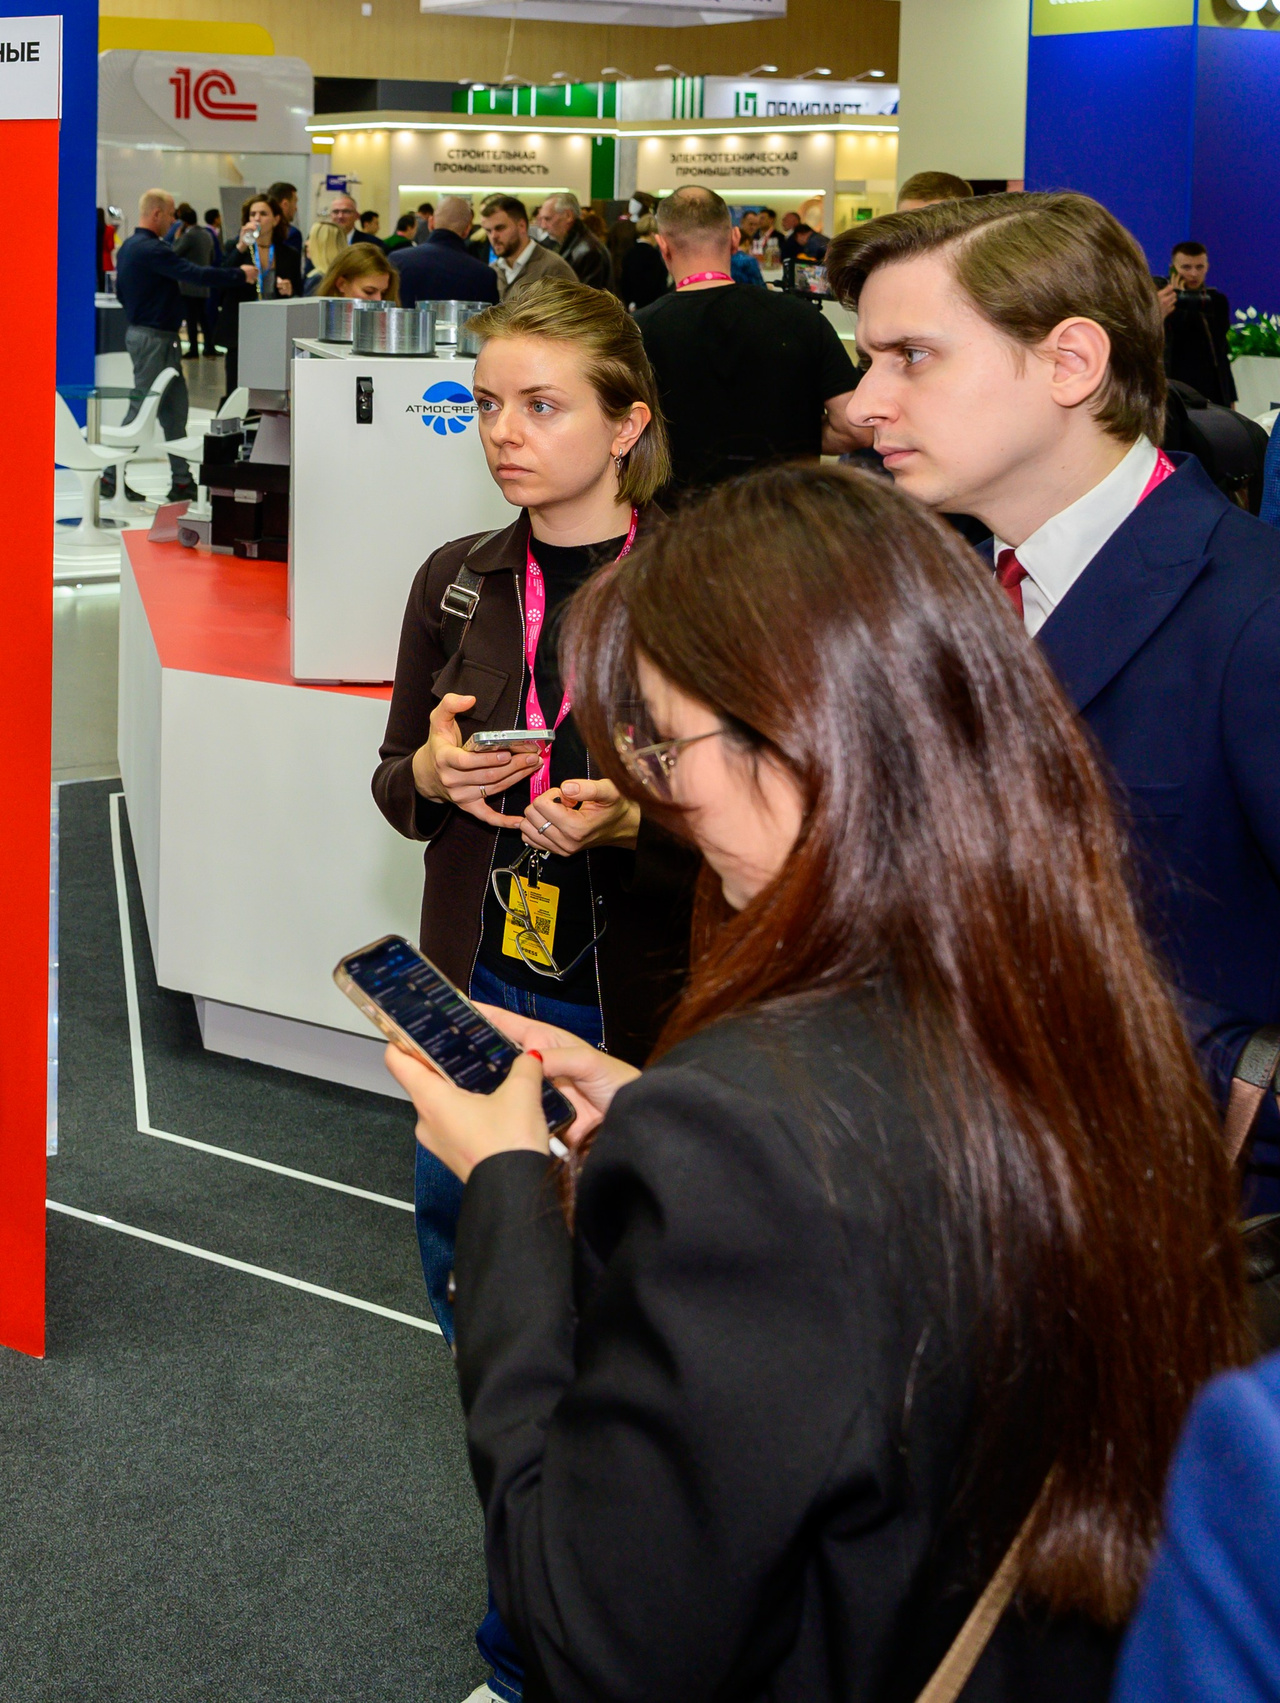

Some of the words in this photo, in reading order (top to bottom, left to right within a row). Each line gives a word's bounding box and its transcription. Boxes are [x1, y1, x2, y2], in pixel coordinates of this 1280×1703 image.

[447, 149, 536, 160] СТРОИТЕЛЬНАЯ
[670, 151, 798, 163] ЭЛЕКТРОТЕХНИЧЕСКАЯ
[434, 162, 549, 175] ПРОМЫШЛЕННОСТЬ
[676, 166, 790, 176] ПРОМЫШЛЕННОСТЬ
[405, 405, 479, 413] АТМОСФЕР
[522, 947, 538, 956] PRESS
